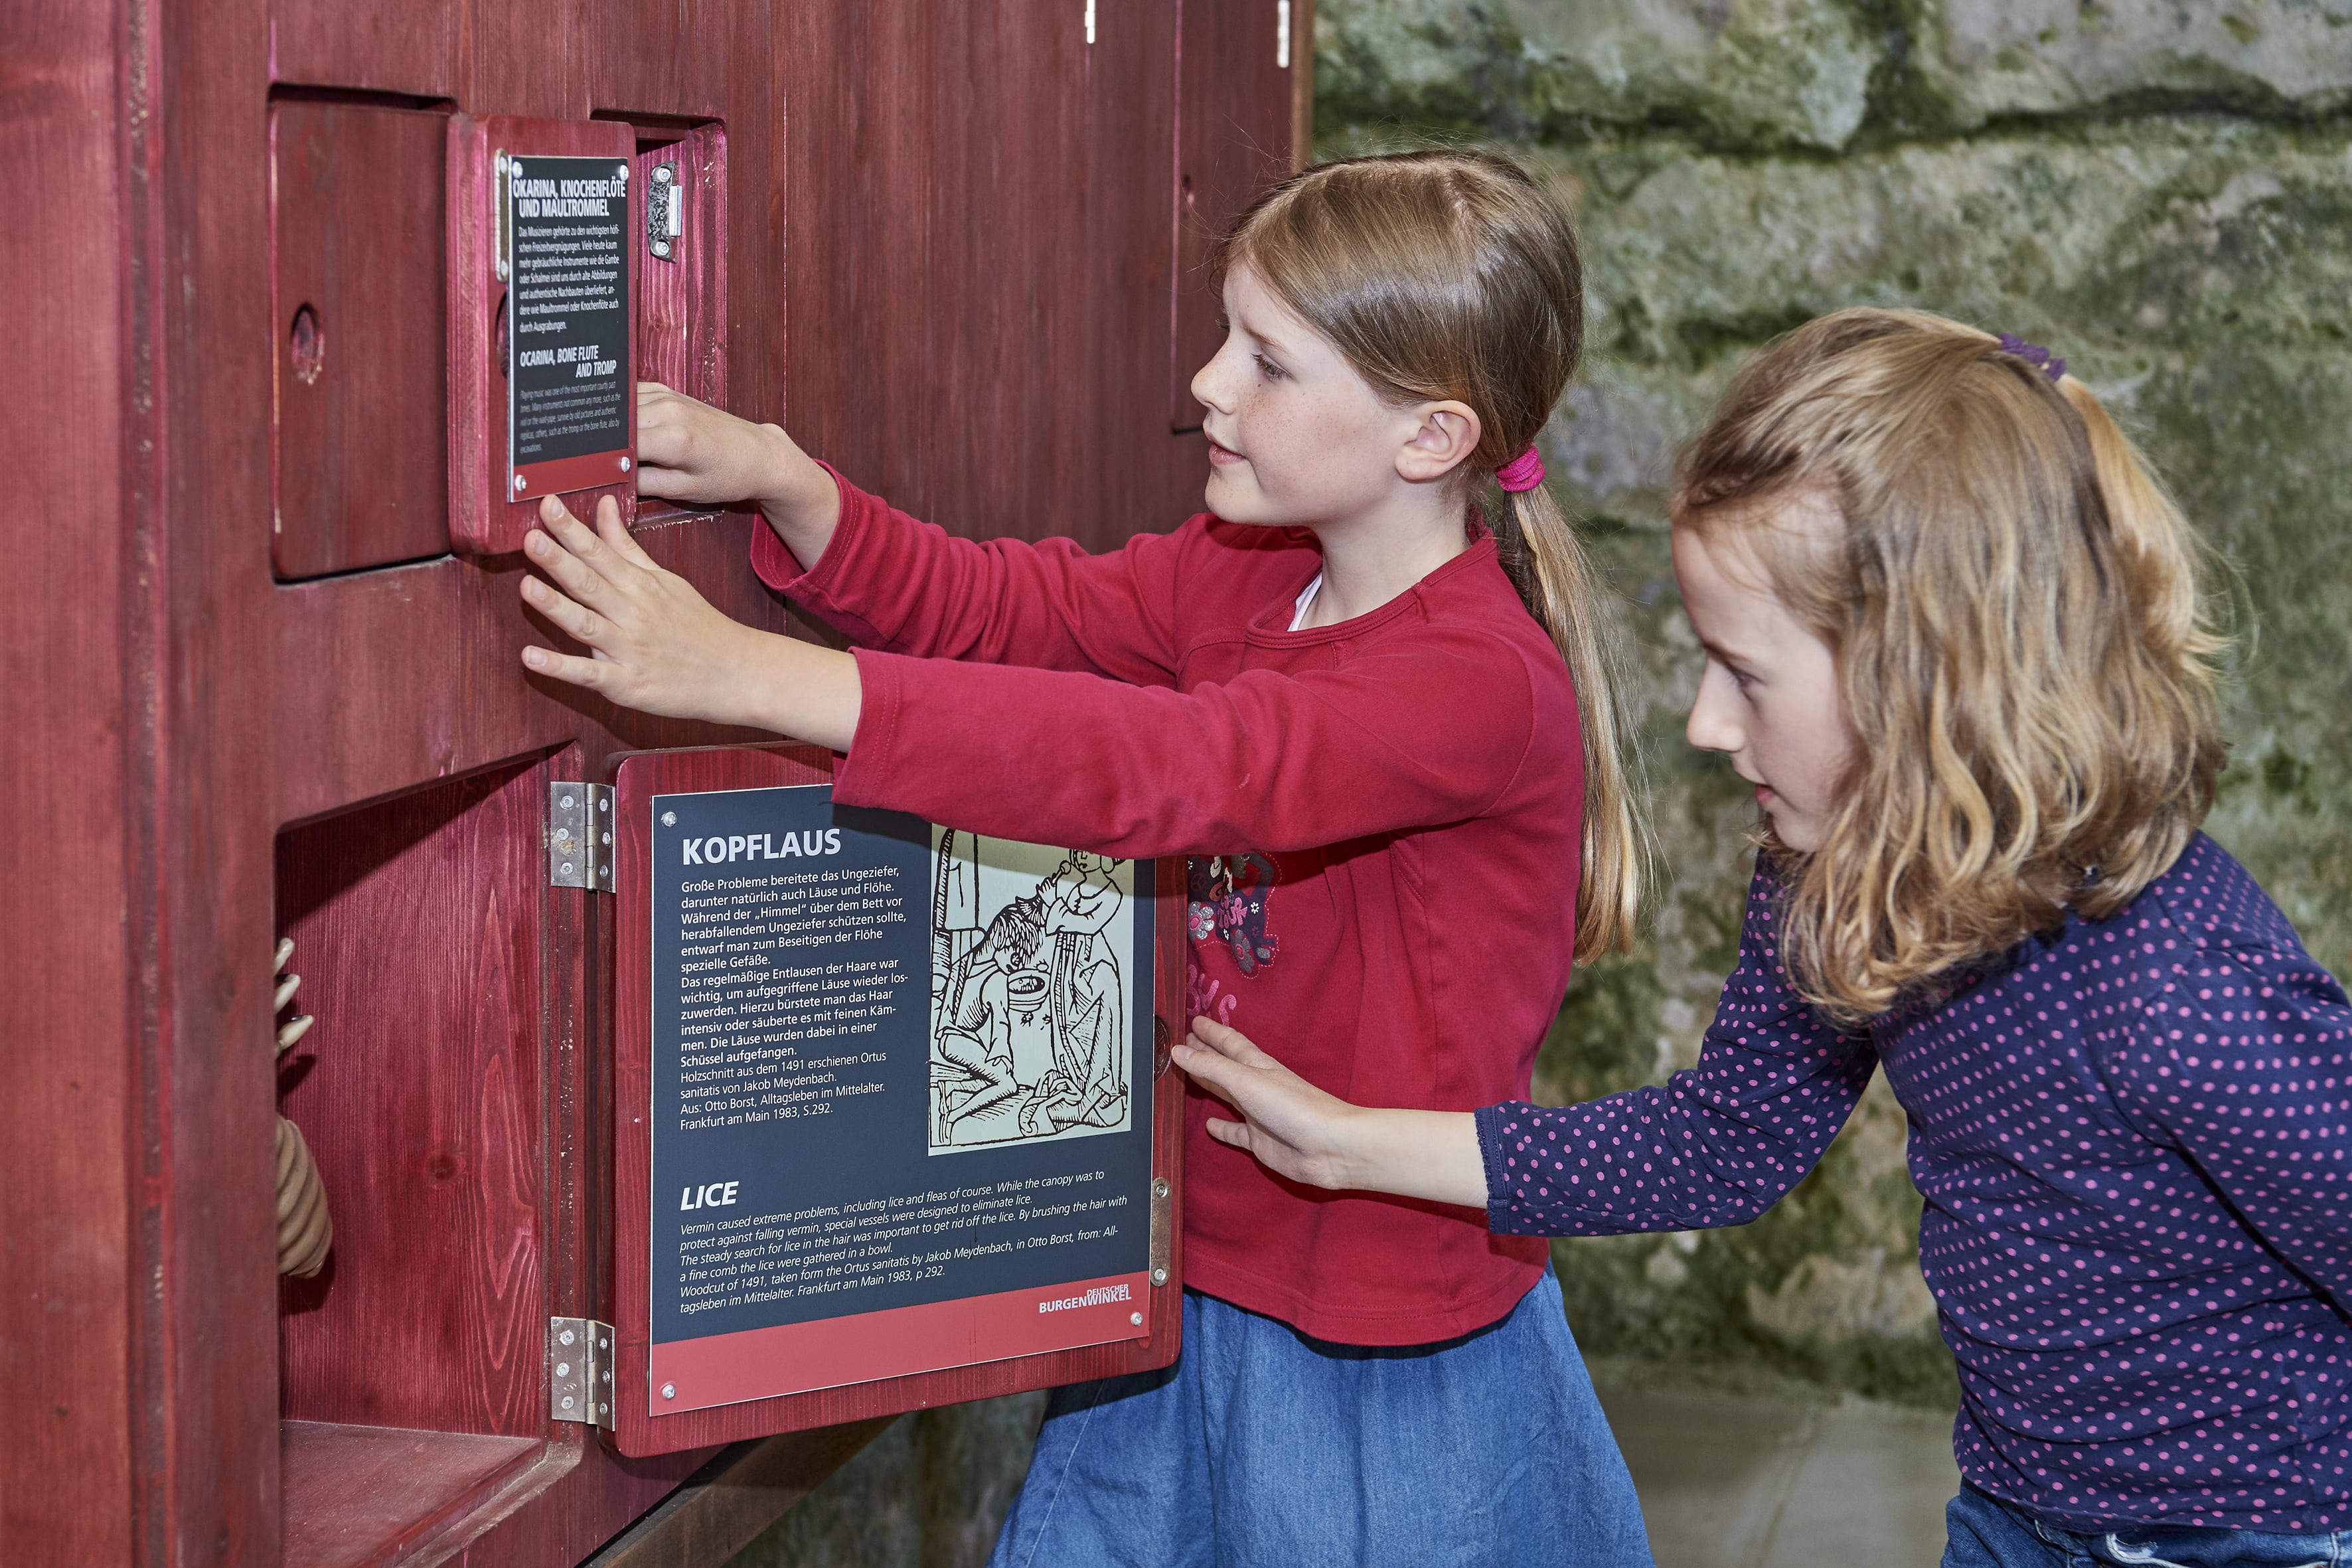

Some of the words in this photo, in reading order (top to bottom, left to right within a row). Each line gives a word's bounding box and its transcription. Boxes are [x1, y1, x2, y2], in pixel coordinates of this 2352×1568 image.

[513, 179, 558, 199] OKARINA,
[561, 175, 625, 197] KNOCHENFLÖTE
[519, 199, 540, 218] UND
[542, 198, 609, 217] MAULTROMMEL
[519, 321, 532, 333] durch
[520, 349, 556, 367] OCARINA,
[557, 347, 577, 363] BONE
[578, 345, 599, 361] FLUTE
[576, 363, 591, 378] AND
[593, 360, 617, 376] TROMP
[682, 828, 841, 865] KOPFLAUS
[682, 880, 714, 892] Große
[718, 877, 767, 890] Probleme
[771, 873, 818, 885] bereitete
[821, 870, 838, 881] das
[842, 866, 899, 881] Ungeziefer,
[681, 896, 728, 908] darunter
[732, 890, 777, 904] natürlich
[781, 888, 805, 900] auch
[809, 888, 837, 898] Läuse
[841, 883, 860, 895] und
[864, 882, 894, 893] Flöhe.
[681, 909, 730, 924] Während
[734, 909, 751, 920] der
[755, 903, 806, 919] „Himmel“
[811, 902, 834, 913] über
[837, 900, 858, 911] dem
[862, 898, 883, 909] Bett
[886, 898, 902, 907] vor
[682, 923, 765, 940] herabfallendem
[769, 917, 826, 934] Ungeziefer
[828, 915, 873, 927] schützen
[876, 911, 905, 923] sollte,
[681, 941, 724, 956] entwarf
[727, 943, 749, 952] man
[753, 940, 775, 949] zum
[779, 934, 831, 947] Beseitigen
[835, 931, 852, 942] der
[855, 928, 882, 940] Flöhe
[681, 958, 726, 975] spezielle
[730, 954, 770, 967] Gefäße.
[682, 977, 700, 988] Das
[704, 971, 769, 987] regelmäßige
[773, 967, 823, 979] Entlausen
[826, 963, 843, 974] der
[846, 961, 876, 972] Haare
[879, 959, 898, 969] war
[681, 990, 722, 1004] wichtig,
[727, 990, 743, 999] um
[746, 981, 818, 998] aufgegriffene
[822, 979, 850, 990] Läuse
[853, 974, 888, 986] wieder
[892, 973, 908, 982] los-
[681, 1005, 736, 1020] zuwerden.
[740, 1002, 773, 1014] Hierzu
[777, 997, 820, 1010] bürstete
[824, 996, 845, 1005] man
[849, 992, 866, 1002] das
[869, 990, 893, 1000] Haar
[681, 1022, 722, 1036] intensiv
[725, 1019, 749, 1031] oder
[752, 1015, 797, 1028] säuberte
[801, 1014, 811, 1023] es
[815, 1010, 831, 1022] mit
[834, 1008, 866, 1020] feinen
[870, 1005, 896, 1016] Käm-
[681, 1042, 707, 1052] men.
[711, 1037, 728, 1048] Die
[732, 1035, 760, 1046] Läuse
[763, 1029, 803, 1042] wurden
[807, 1025, 834, 1038] dabei
[838, 1024, 847, 1034] in
[851, 1022, 877, 1033] einer
[681, 1052, 723, 1067] Schüssel
[726, 1048, 797, 1063] aufgefangen.
[681, 1067, 734, 1083] Holzschnitt
[737, 1067, 753, 1077] aus
[756, 1063, 777, 1074] dem
[781, 1059, 803, 1071] 1491
[808, 1056, 858, 1069] erschienen
[861, 1052, 886, 1063] Ortus
[680, 1084, 720, 1099] sanitatis
[722, 1085, 740, 1094] von
[743, 1078, 770, 1091] Jakob
[774, 1071, 836, 1089] Meydenbach.
[680, 1104, 701, 1115] Aus:
[705, 1101, 727, 1111] Otto
[730, 1097, 757, 1109] Borst,
[760, 1090, 818, 1105] Alltagsleben
[821, 1087, 832, 1098] im
[836, 1082, 884, 1096] Mittelalter.
[680, 1116, 724, 1130] Frankfurt
[728, 1115, 742, 1125] am
[745, 1110, 769, 1123] Main
[774, 1107, 800, 1119] 1983,
[803, 1103, 832, 1115] S.292.
[680, 1181, 740, 1211] LICE
[681, 1221, 714, 1235] Vermin
[717, 1215, 751, 1230] caused
[753, 1213, 792, 1225] extreme
[794, 1206, 839, 1222] problems,
[844, 1199, 886, 1213] including
[888, 1196, 903, 1207] lice
[906, 1192, 924, 1205] and
[927, 1191, 947, 1202] fleas
[949, 1187, 961, 1199] of
[962, 1186, 992, 1197] course.
[997, 1180, 1022, 1192] While
[1025, 1178, 1039, 1189] the
[1042, 1176, 1073, 1186] canopy
[1076, 1173, 1093, 1182] was
[680, 1237, 715, 1253] protect
[718, 1232, 753, 1247] against
[755, 1228, 784, 1240] falling
[787, 1222, 821, 1236] vermin,
[824, 1216, 856, 1233] special
[859, 1212, 889, 1226] vessels
[892, 1212, 915, 1221] were
[917, 1203, 959, 1219] designed
[961, 1204, 970, 1212] to
[973, 1198, 1013, 1211] eliminate
[1016, 1194, 1032, 1205] lice.
[689, 1269, 707, 1281] fine
[710, 1264, 737, 1277] comb
[741, 1262, 755, 1273] the
[758, 1260, 774, 1271] lice
[777, 1257, 801, 1268] were
[803, 1248, 846, 1267] gathered
[848, 1248, 856, 1258] in
[868, 1242, 892, 1255] bowl.
[1040, 1289, 1131, 1313] BURGENWINKEL
[1087, 1284, 1129, 1296] DEUTSCHER
